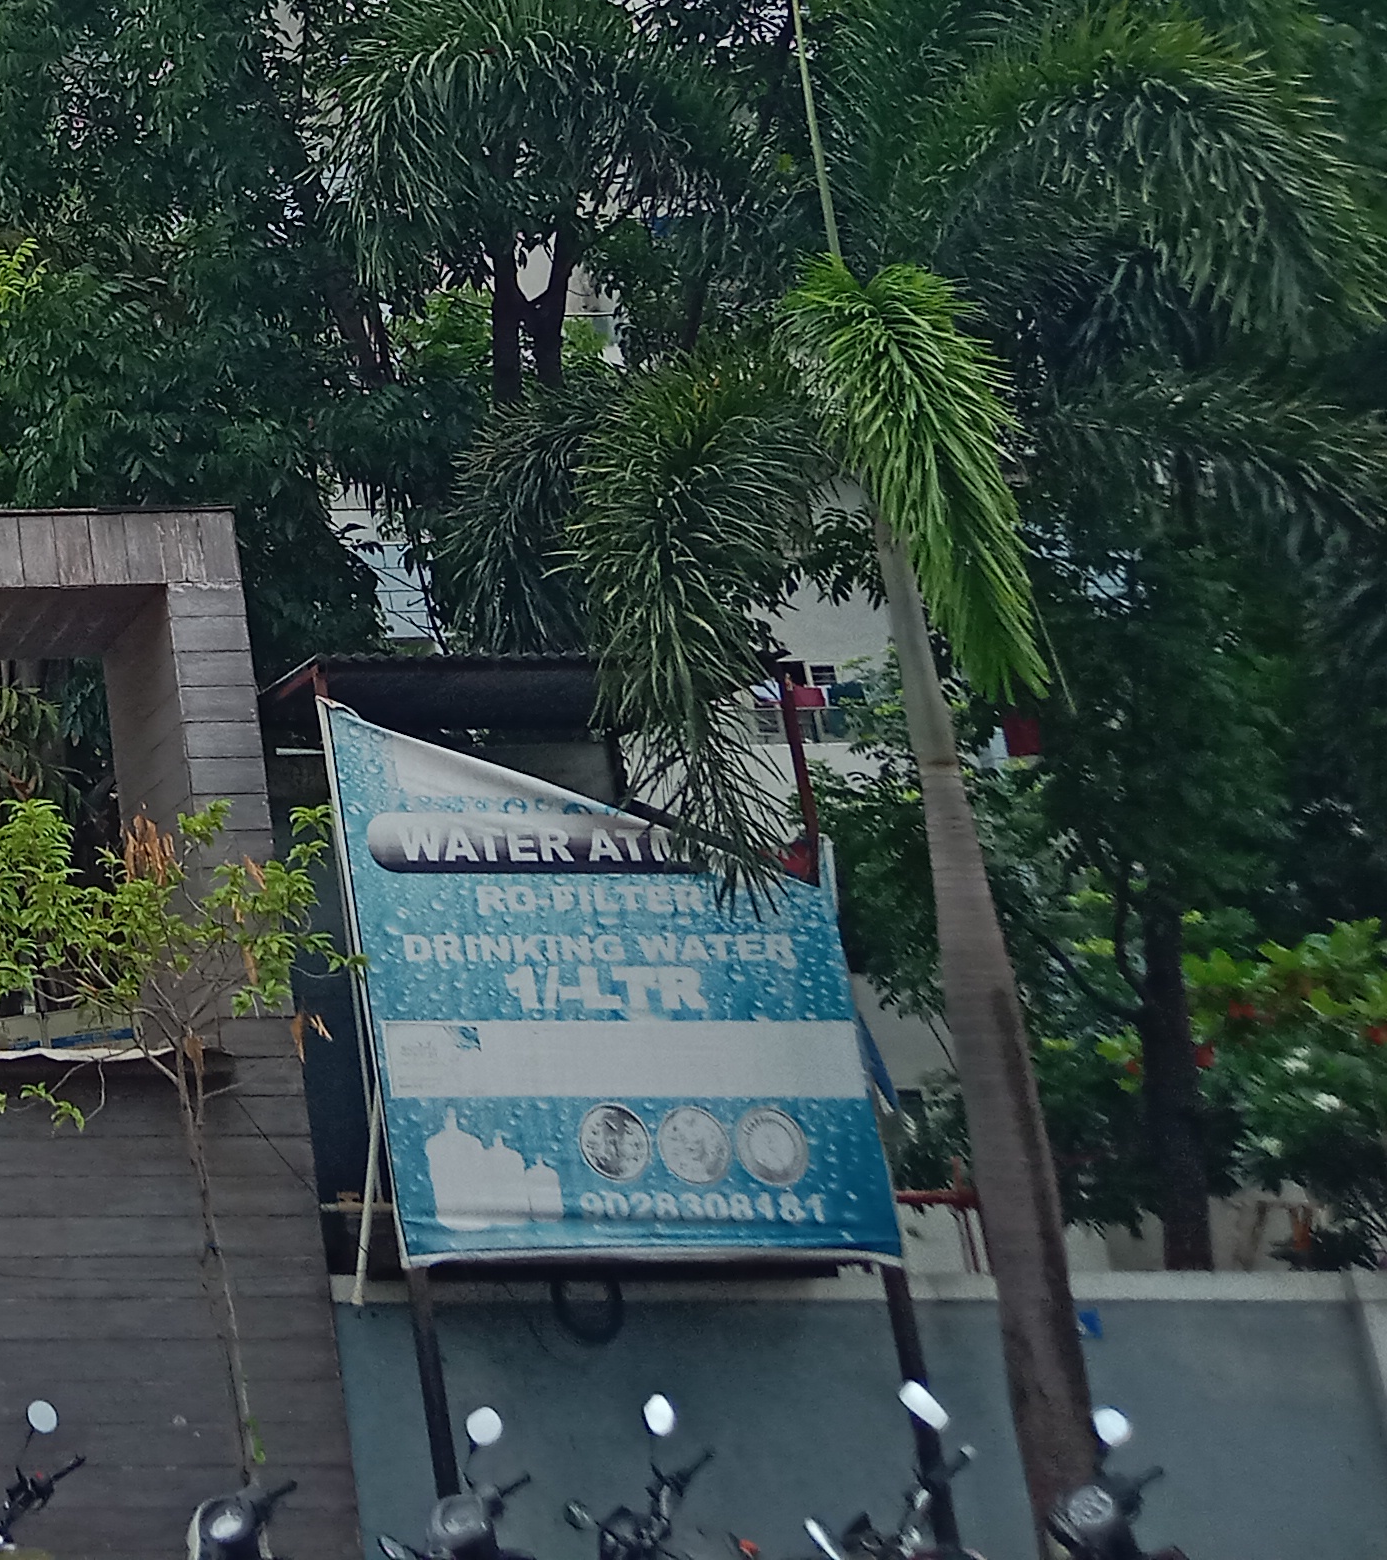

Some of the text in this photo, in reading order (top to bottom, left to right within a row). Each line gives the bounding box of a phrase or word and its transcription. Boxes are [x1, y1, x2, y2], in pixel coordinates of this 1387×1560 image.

[397, 826, 574, 863] WATER
[475, 885, 705, 916] RO-FILTER
[403, 932, 798, 969] DRINKING WATER
